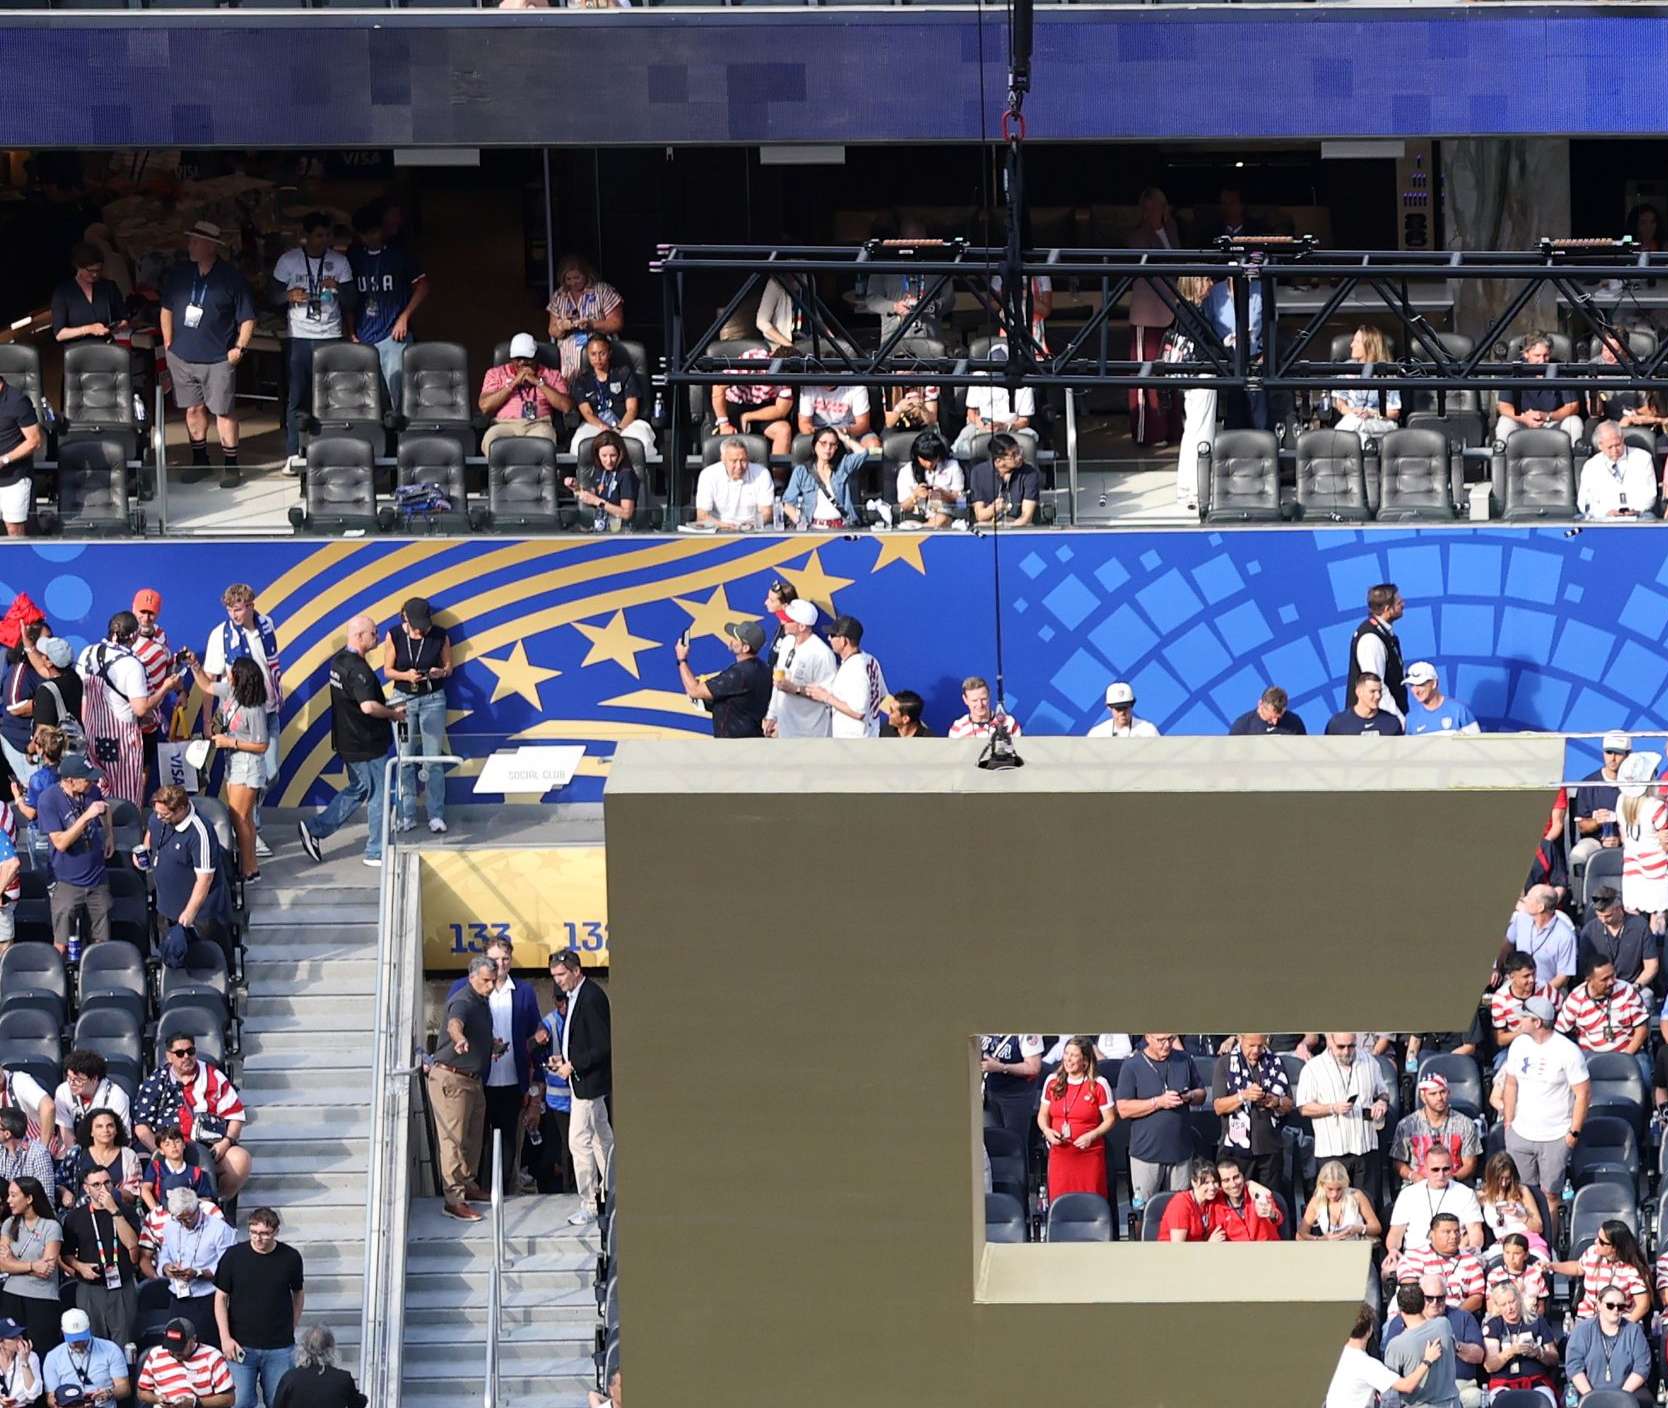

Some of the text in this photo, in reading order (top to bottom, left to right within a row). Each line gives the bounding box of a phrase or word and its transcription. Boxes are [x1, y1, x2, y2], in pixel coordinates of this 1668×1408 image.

[358, 275, 393, 292] USA
[173, 754, 185, 787] VISA
[542, 769, 566, 780] CLUB
[564, 922, 608, 953] 13
